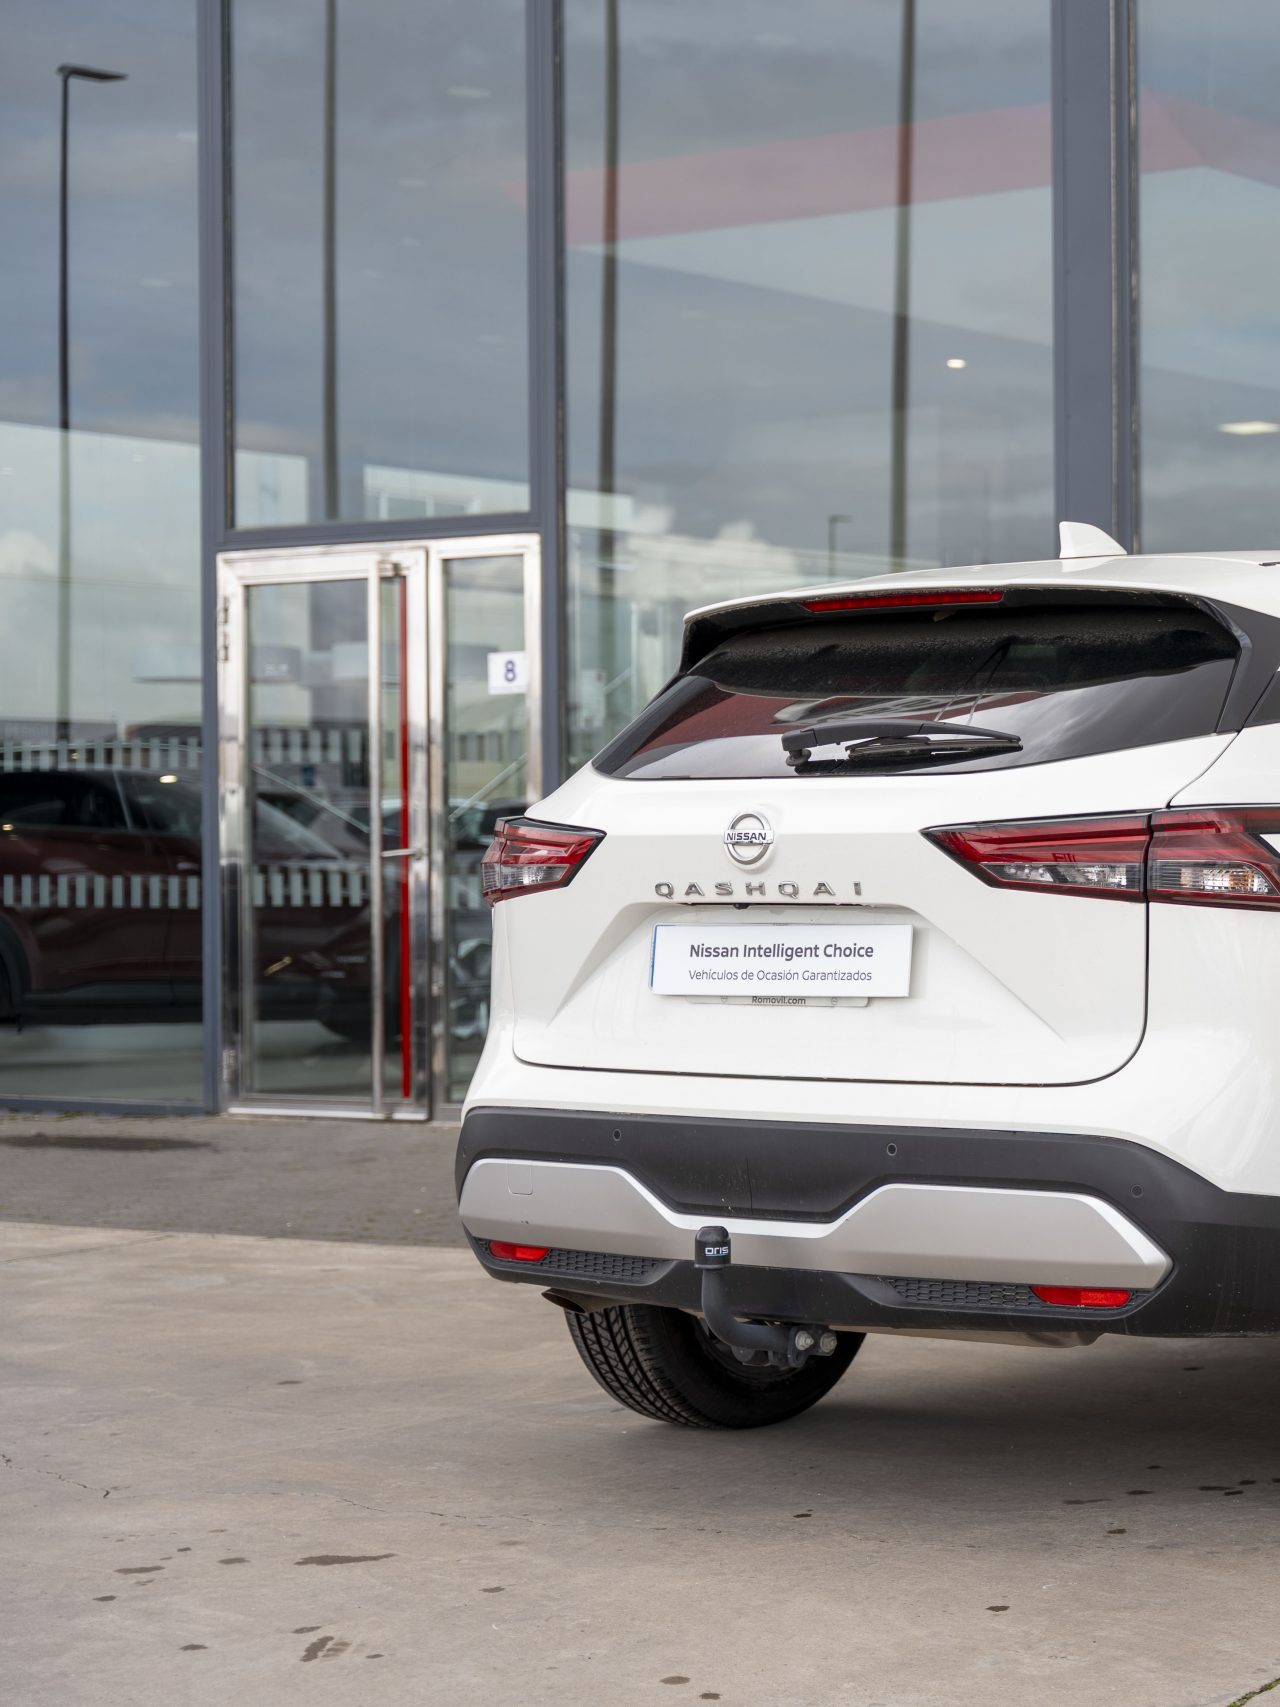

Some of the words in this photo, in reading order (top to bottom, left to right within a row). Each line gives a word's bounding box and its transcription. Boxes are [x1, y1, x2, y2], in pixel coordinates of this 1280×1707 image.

[504, 660, 516, 682] 8
[726, 832, 767, 841] NISSAN
[655, 881, 862, 899] QASHQAI
[689, 943, 739, 958] Nissan
[743, 943, 819, 962] Intelligent
[823, 943, 874, 958] Choice
[689, 969, 738, 981] Vehículos
[741, 970, 754, 981] de
[757, 969, 799, 981] Ocasión
[802, 970, 873, 981] Garantizados
[751, 995, 806, 1005] Romovil.com
